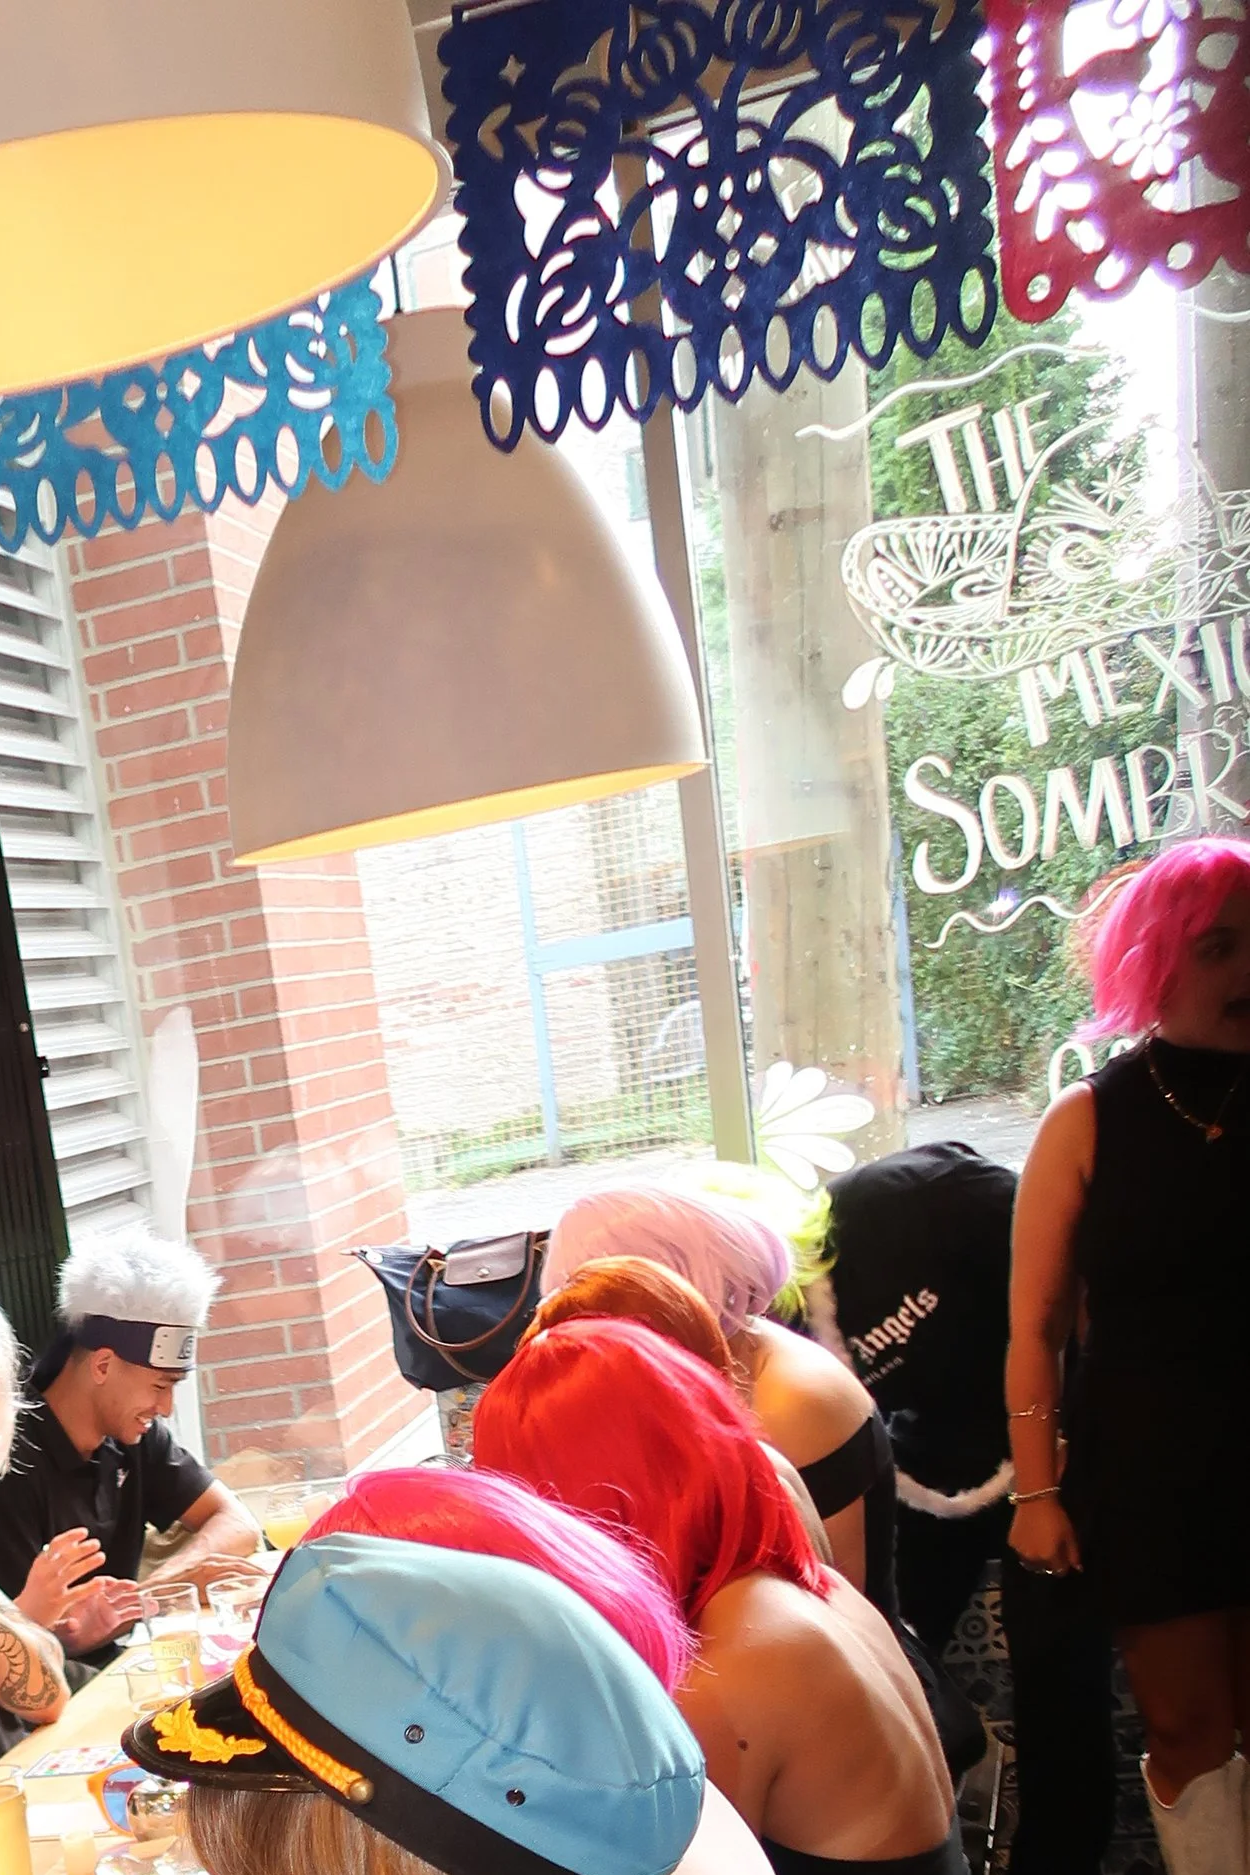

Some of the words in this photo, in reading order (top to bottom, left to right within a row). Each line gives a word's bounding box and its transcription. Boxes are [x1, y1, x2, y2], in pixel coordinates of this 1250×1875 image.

[895, 391, 1052, 514] THE
[904, 728, 1250, 894] SOMBR
[847, 1288, 939, 1366] Angels
